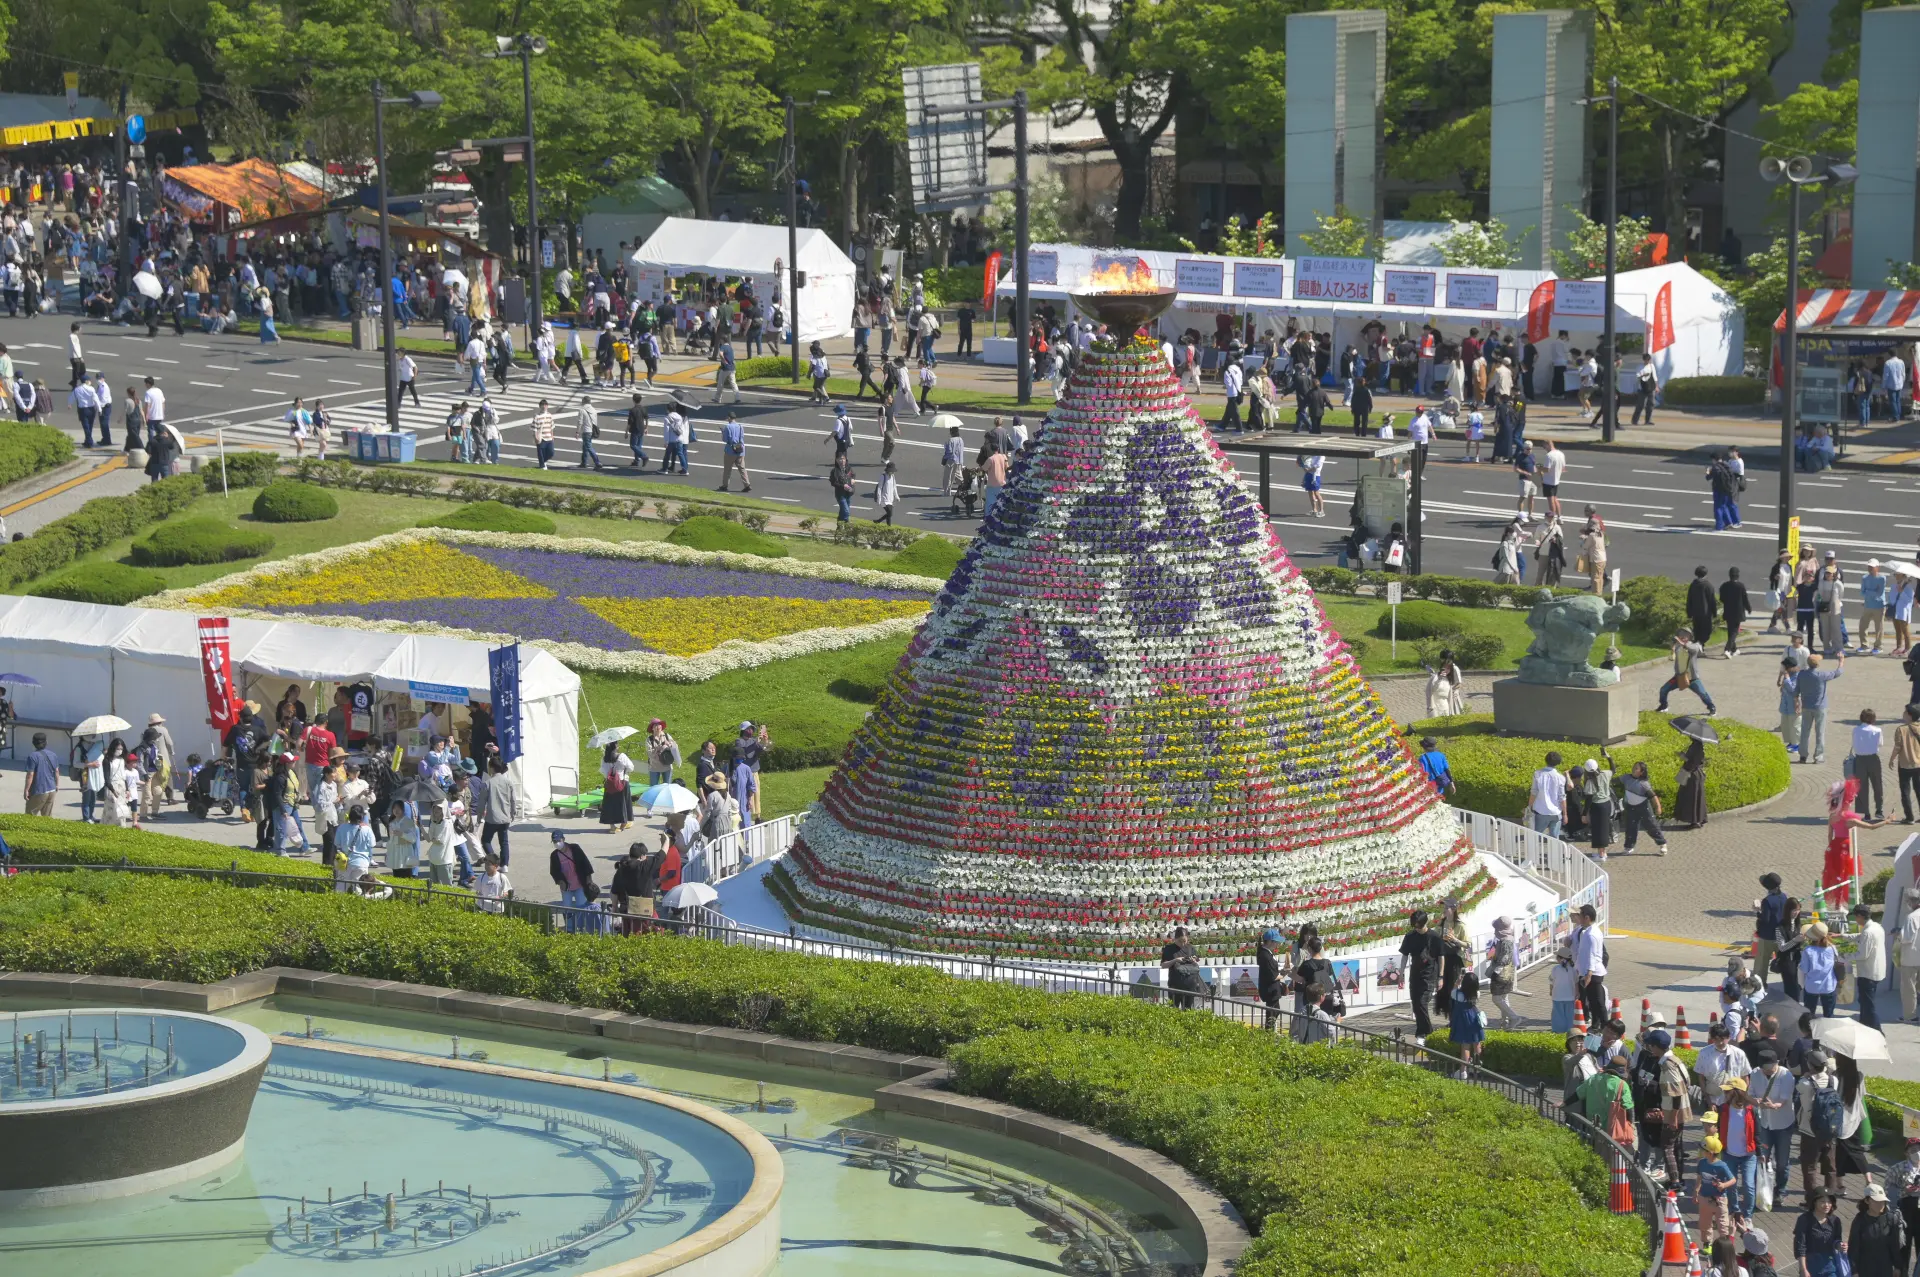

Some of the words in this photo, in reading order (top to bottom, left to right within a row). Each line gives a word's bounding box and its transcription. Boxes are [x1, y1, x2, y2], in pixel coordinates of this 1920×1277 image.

[1313, 260, 1367, 272] 広島経済大学
[1298, 280, 1369, 299] 興動人ひろば
